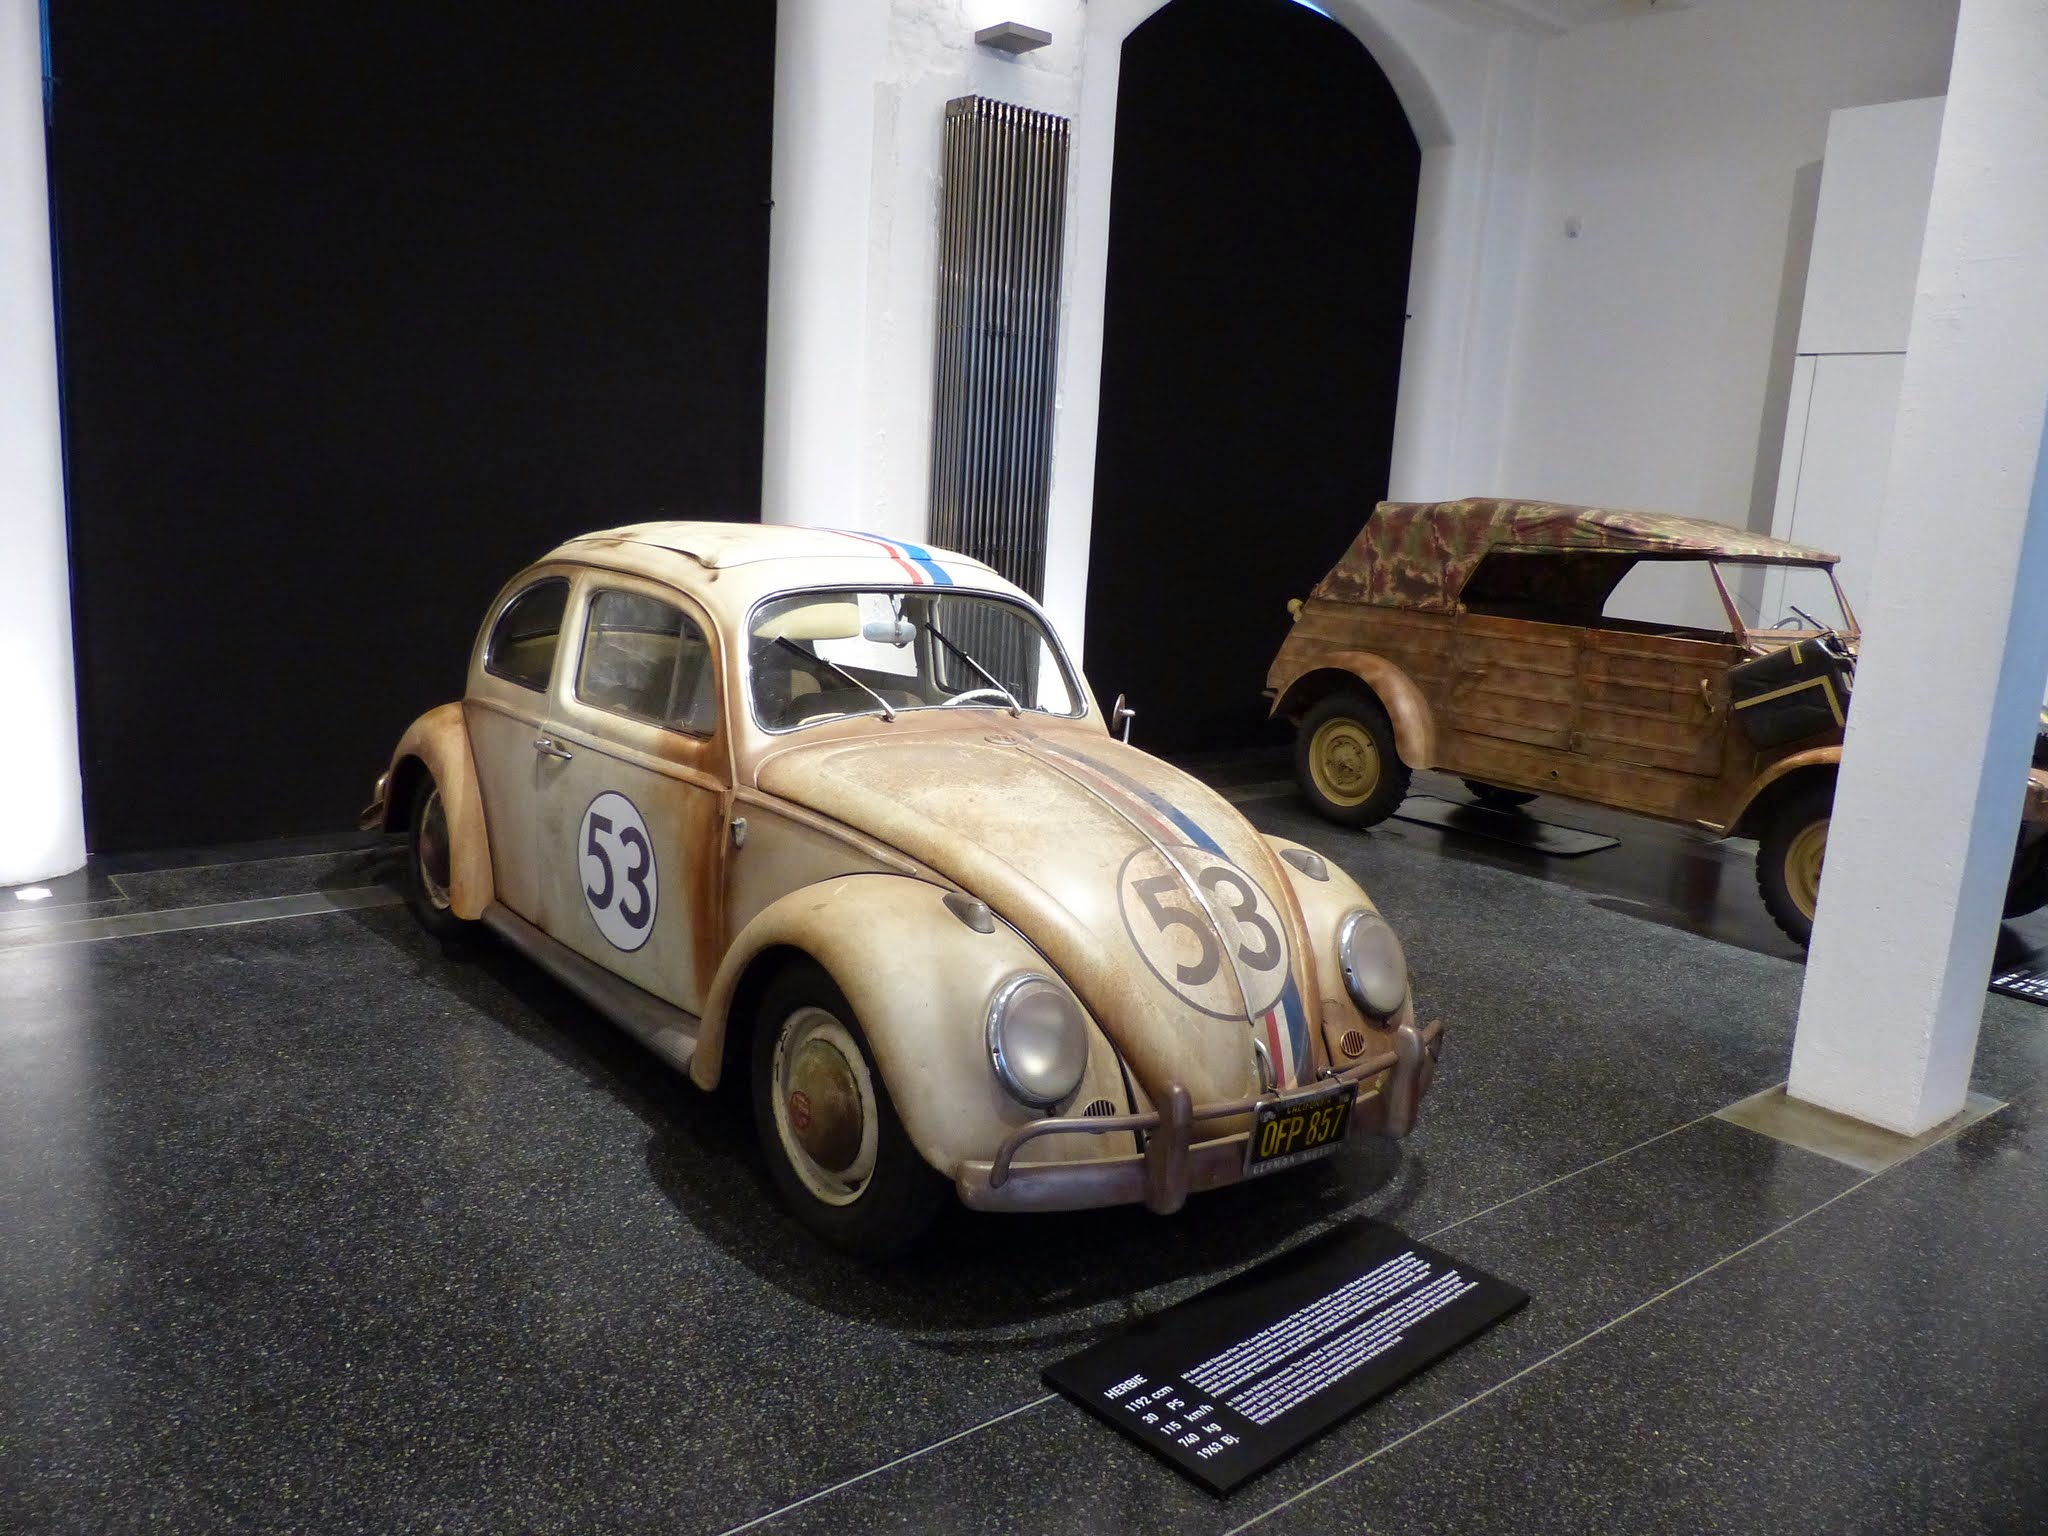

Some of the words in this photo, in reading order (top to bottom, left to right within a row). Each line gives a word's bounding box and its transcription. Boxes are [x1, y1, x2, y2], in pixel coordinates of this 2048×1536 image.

[586, 811, 651, 930] 53
[1130, 866, 1282, 986] 53
[1260, 1116, 1305, 1159] OFP
[1305, 1104, 1345, 1146] 857
[1104, 1374, 1147, 1399] HERBIE
[1125, 1397, 1152, 1411] 1192
[1152, 1386, 1173, 1399] ccm
[1142, 1413, 1159, 1423] 30
[1166, 1399, 1184, 1410] PS
[1160, 1421, 1181, 1435] 115
[1184, 1405, 1213, 1422] km/h
[1178, 1433, 1200, 1447] 740
[1202, 1423, 1221, 1433] kg
[1197, 1442, 1223, 1458] 1963
[1220, 1434, 1239, 1445] Bj.
